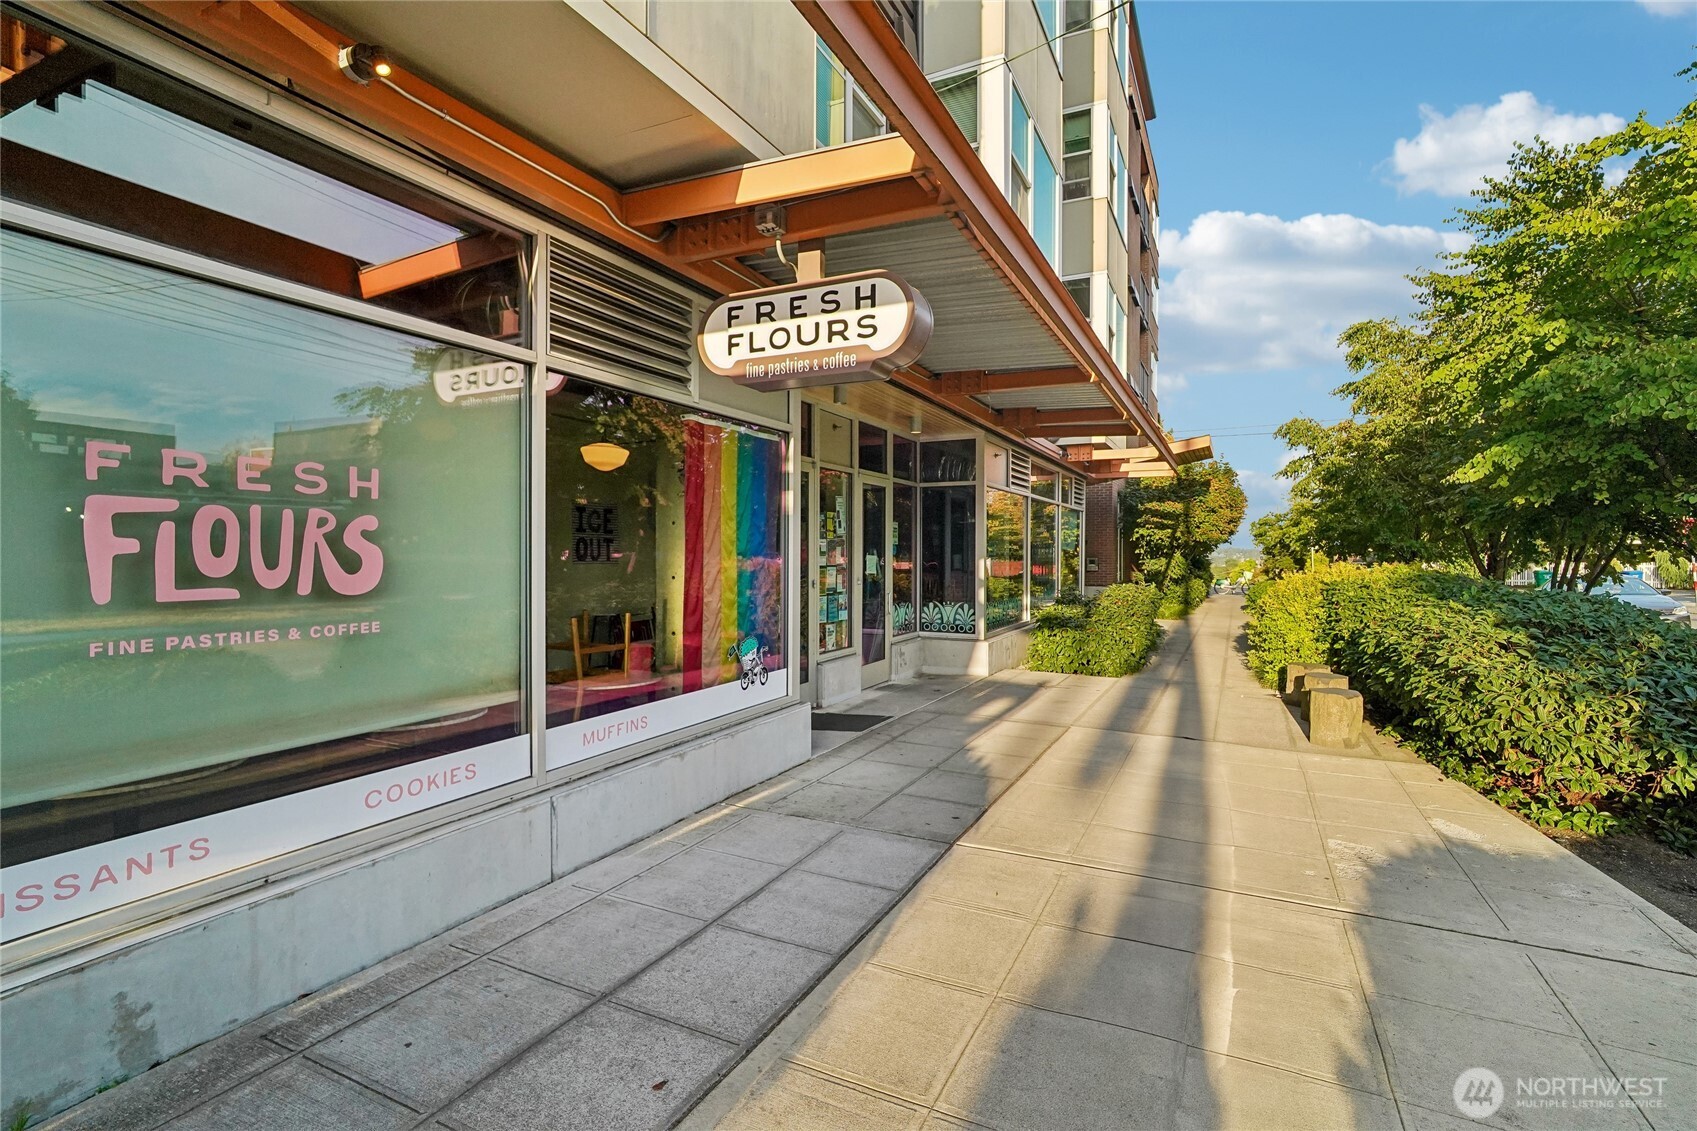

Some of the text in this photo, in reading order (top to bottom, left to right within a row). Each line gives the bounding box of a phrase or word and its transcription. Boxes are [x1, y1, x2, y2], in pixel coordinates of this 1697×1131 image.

[727, 283, 877, 329] FRESH
[727, 314, 878, 356] FLOURS
[745, 351, 857, 379] fine pastries & coffee
[85, 441, 380, 500] FRESH
[575, 505, 614, 535] ICE
[83, 494, 384, 605] FLOURS
[575, 536, 615, 562] OUT
[89, 621, 381, 658] FINE PASTRIES & COFFEE
[582, 715, 649, 747] MUFFINS
[363, 763, 478, 809] COOKIES
